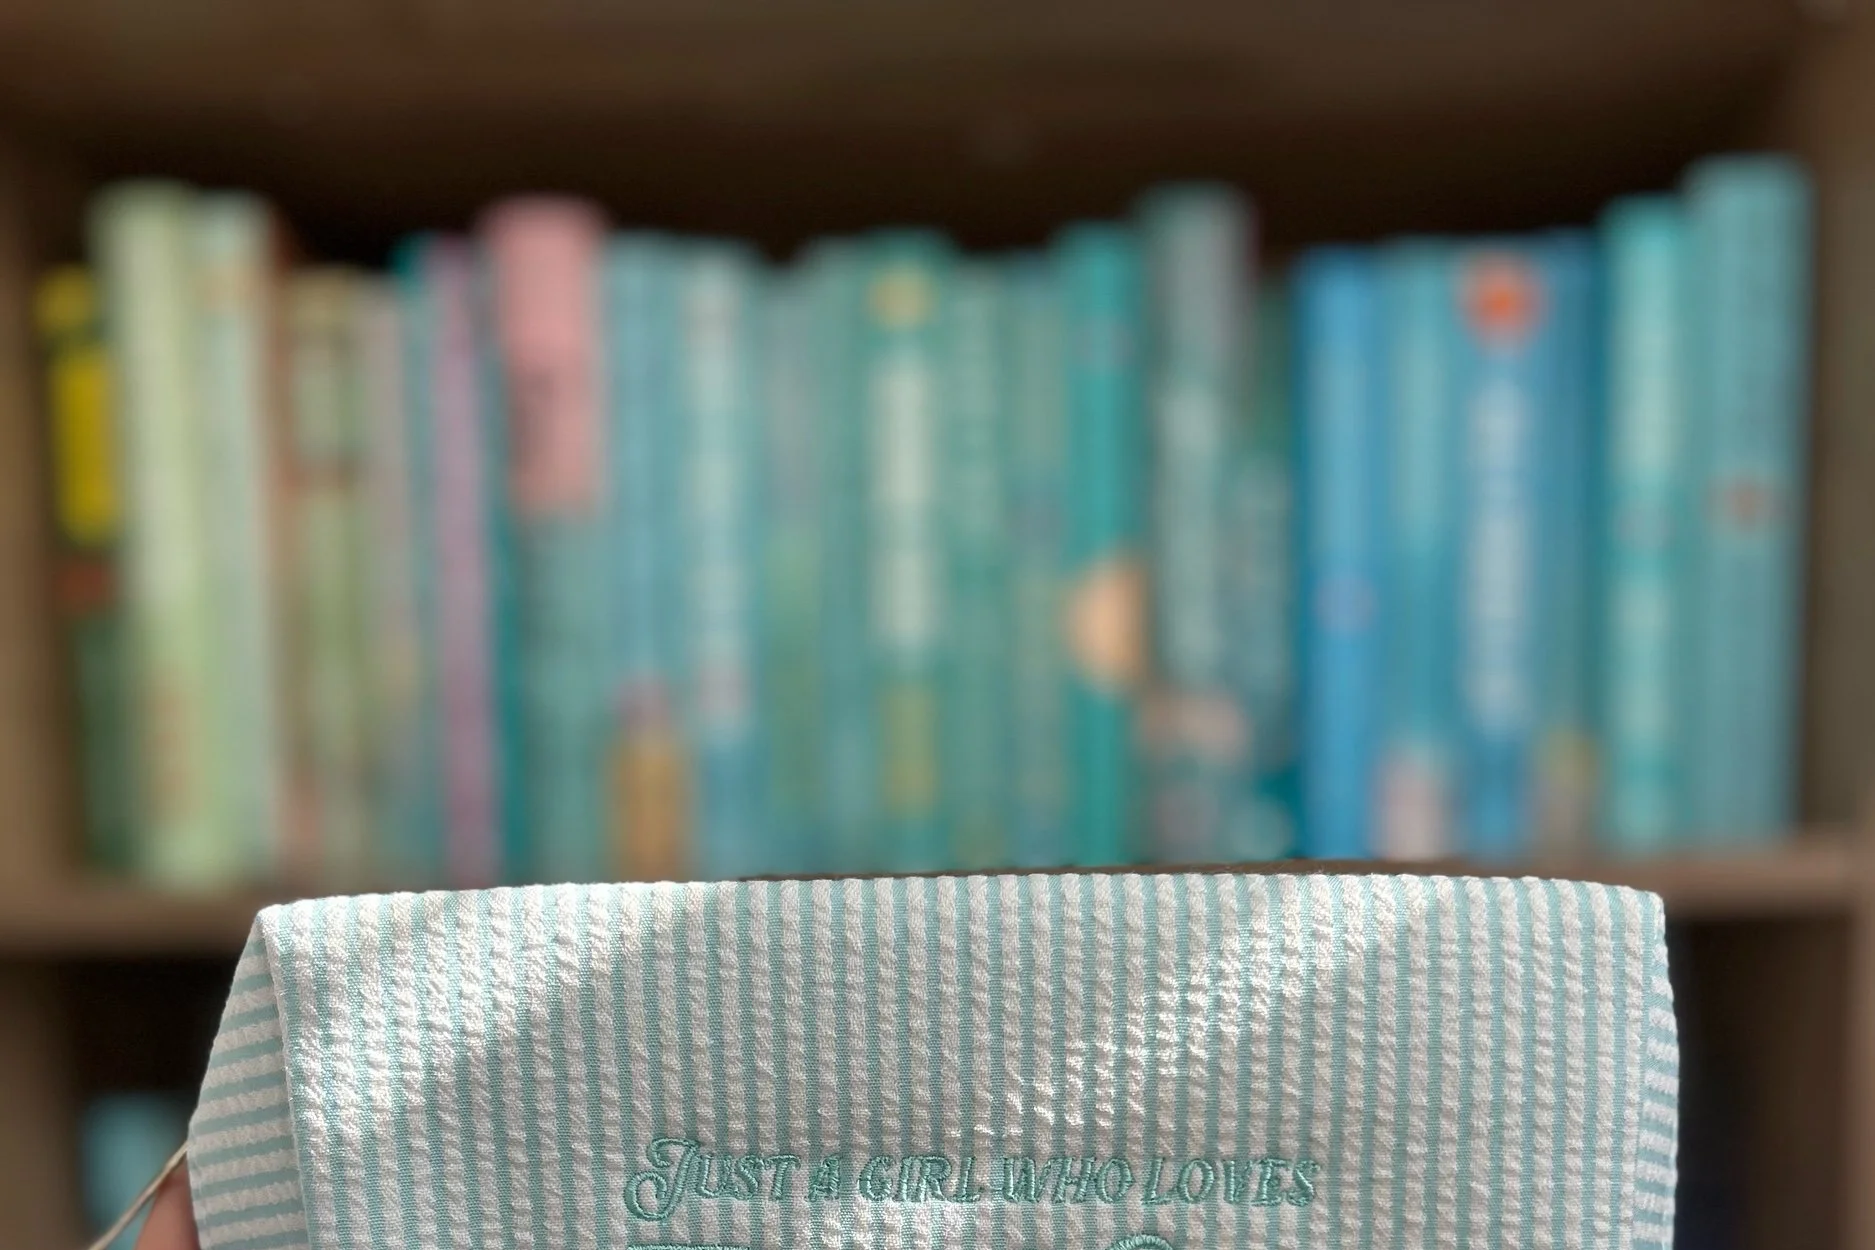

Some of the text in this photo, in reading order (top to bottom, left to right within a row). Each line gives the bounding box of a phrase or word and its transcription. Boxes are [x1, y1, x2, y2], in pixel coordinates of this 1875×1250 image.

[624, 1137, 1321, 1222] JUST A GIRL WHO LOVES
